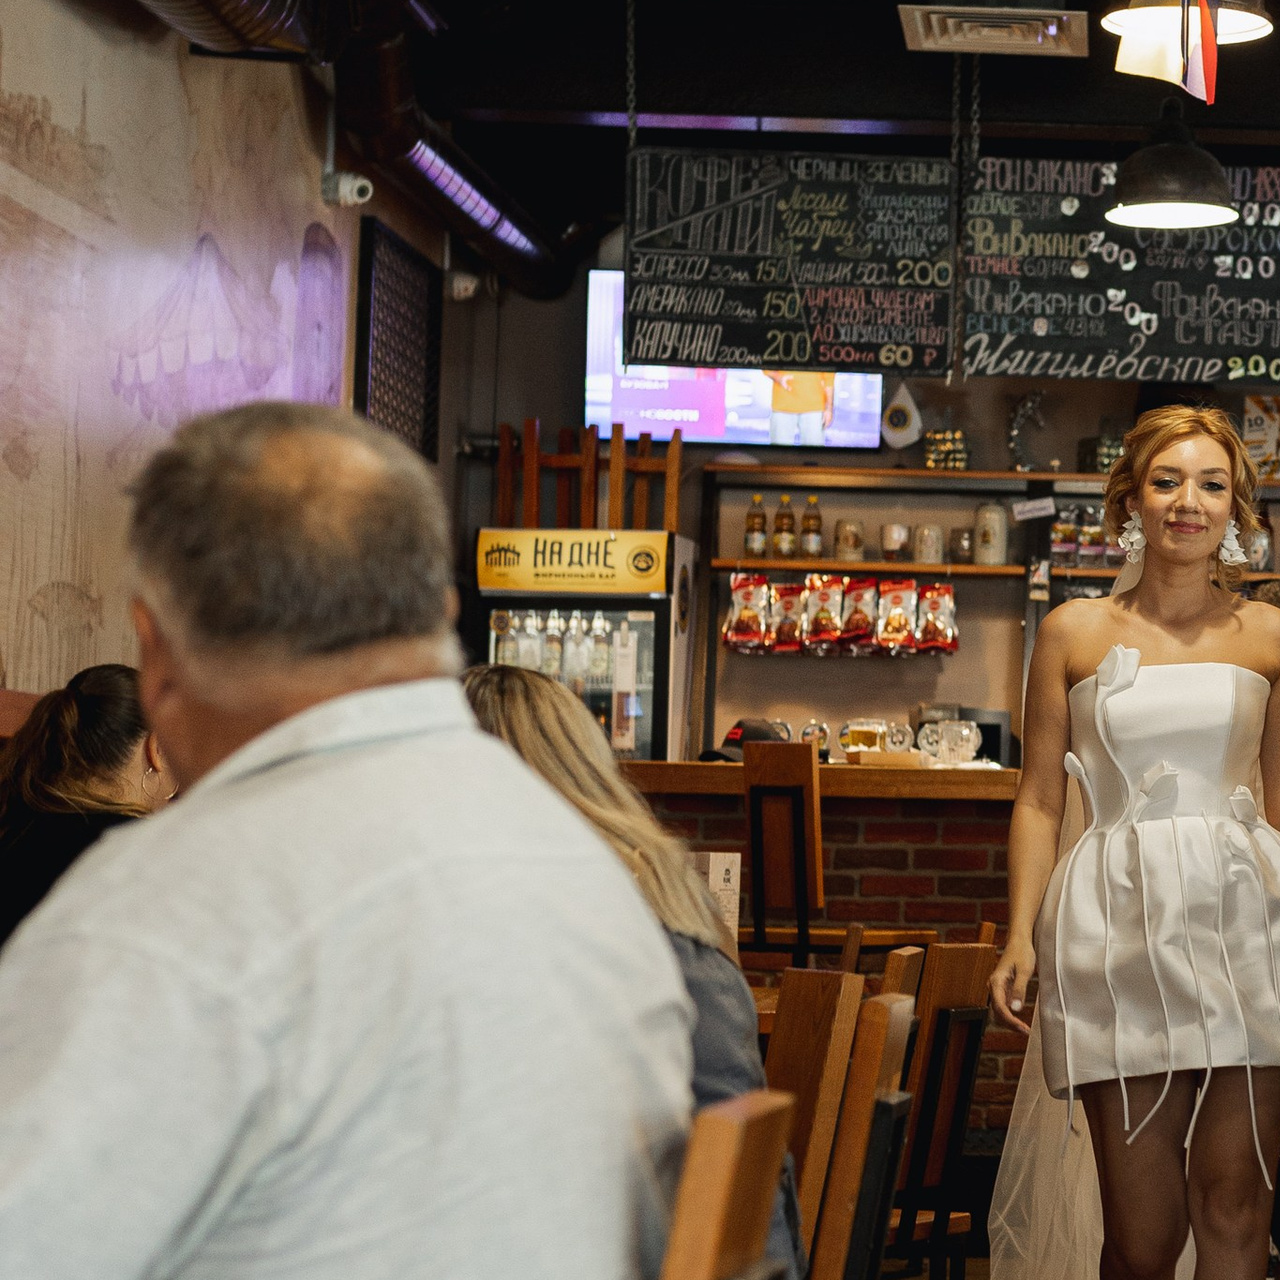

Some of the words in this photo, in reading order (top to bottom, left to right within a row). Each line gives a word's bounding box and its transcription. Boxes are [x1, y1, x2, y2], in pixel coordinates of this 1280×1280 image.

[896, 258, 954, 287] 200
[629, 282, 725, 317] АМЕРИКАНО
[762, 290, 801, 319] 150
[965, 314, 1062, 336] ВЕНСКЕ
[631, 318, 723, 363] КАПУЧИНО
[762, 328, 811, 363] 200
[880, 343, 914, 367] 60
[533, 538, 562, 569] НА
[567, 538, 617, 570] ДНЕ
